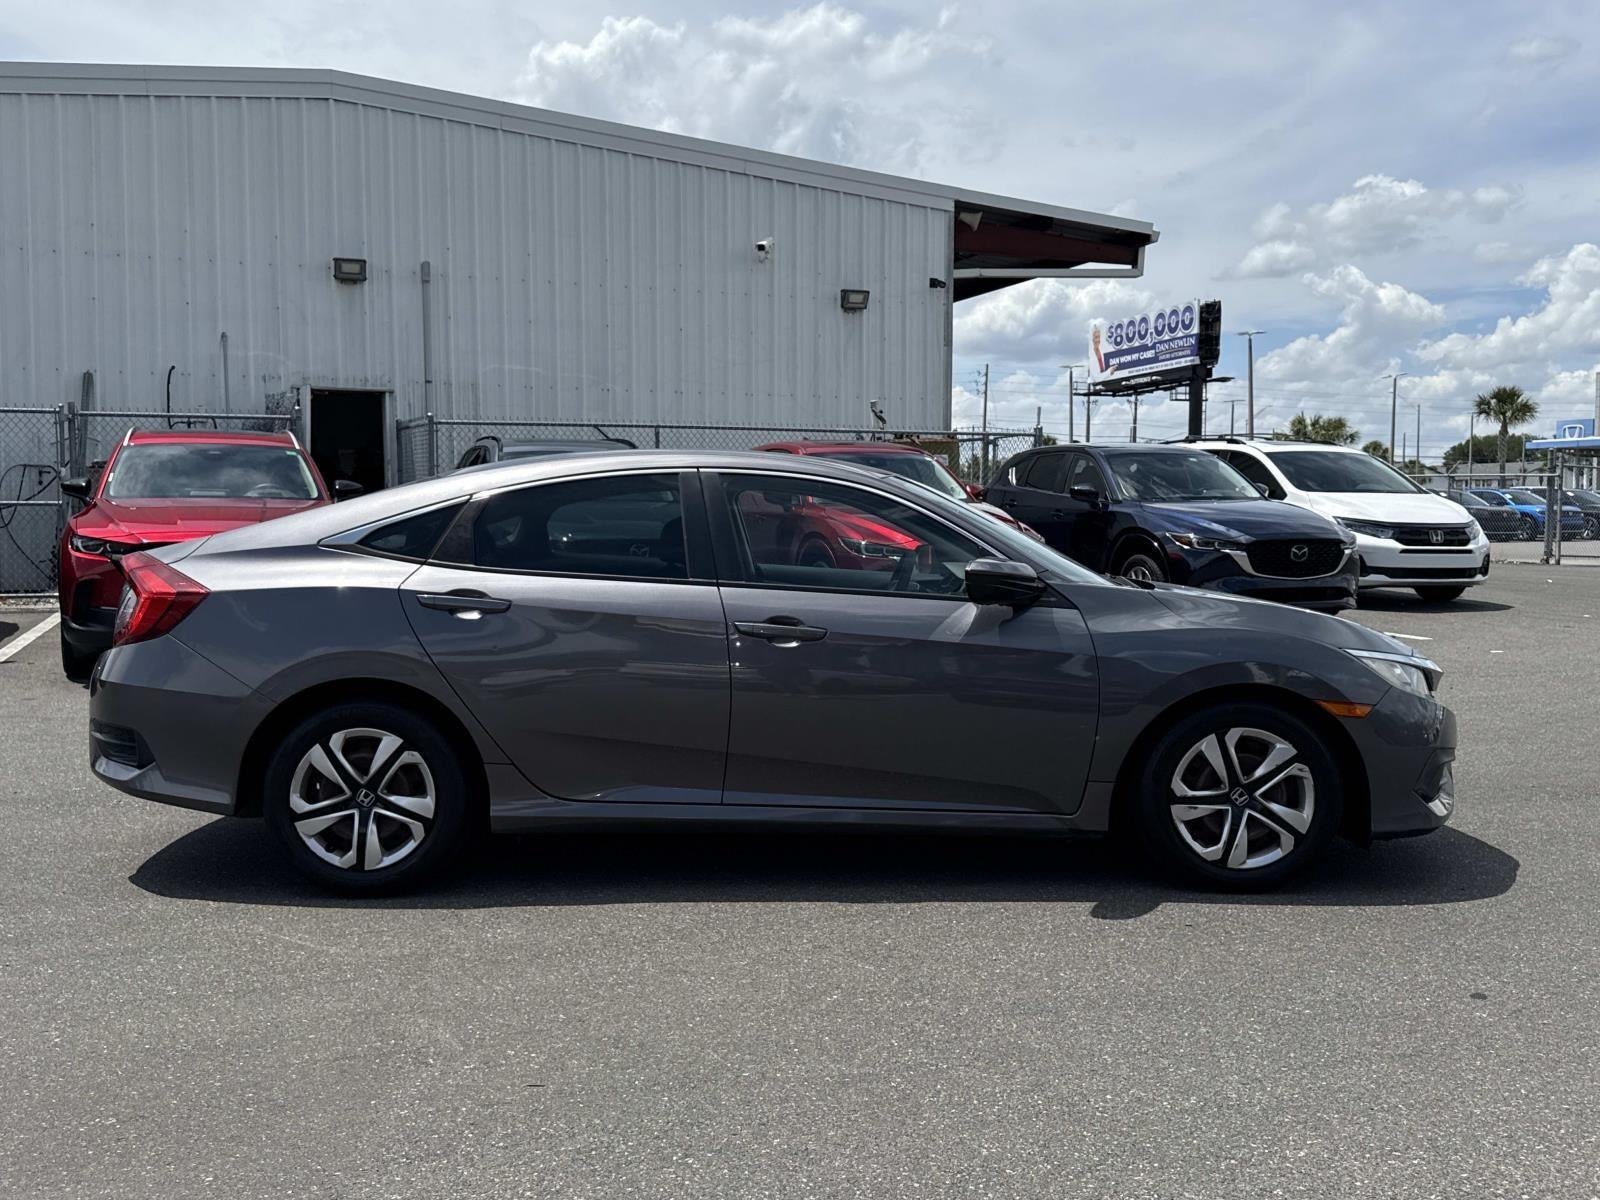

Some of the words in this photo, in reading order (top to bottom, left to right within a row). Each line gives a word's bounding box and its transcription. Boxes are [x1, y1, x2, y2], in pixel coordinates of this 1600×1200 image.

[1107, 305, 1194, 348] $800,000
[1155, 342, 1170, 353] DAN
[1170, 336, 1195, 349] NEWLIN
[1109, 357, 1120, 366] DAN
[1120, 355, 1132, 363] WON
[1132, 353, 1140, 362] MY
